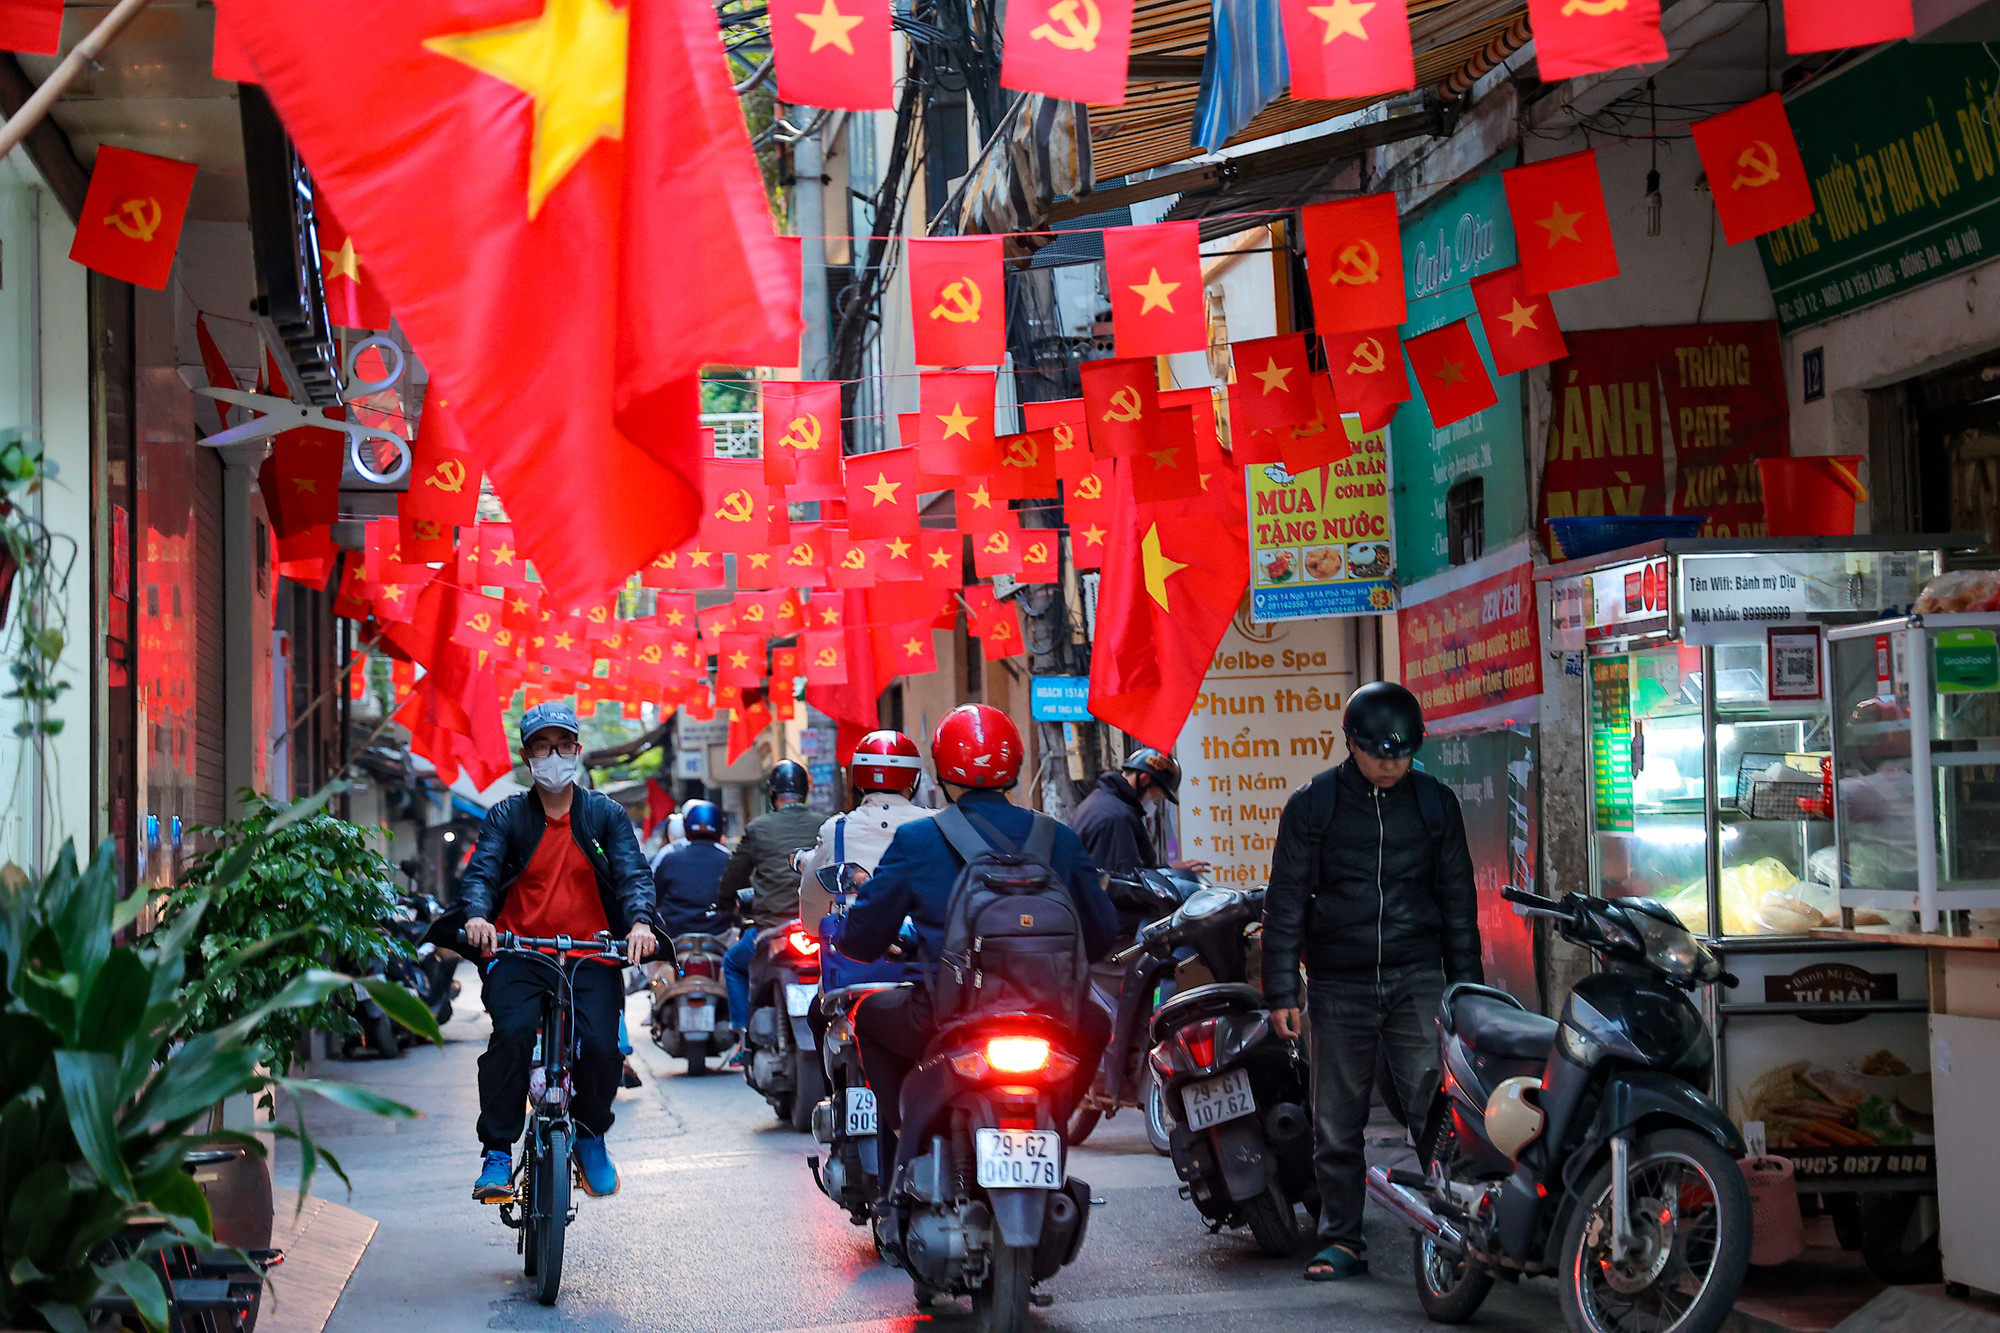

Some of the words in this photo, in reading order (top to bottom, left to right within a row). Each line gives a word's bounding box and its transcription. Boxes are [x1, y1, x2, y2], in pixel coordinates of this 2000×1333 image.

[1815, 153, 1868, 243] NƯỚC
[1854, 142, 1886, 226] ÉP
[1879, 138, 1925, 216] HOA
[1912, 96, 1960, 209] QUẢ
[1806, 291, 1819, 312] 12
[1841, 277, 1853, 301] 18
[1853, 267, 1871, 295] YÊN
[1946, 231, 1963, 260] HÀ
[1961, 225, 1983, 257] NỘI
[1675, 337, 1750, 389] TRỨNG
[1806, 356, 1821, 395] 12
[1680, 405, 1732, 448] PATE
[1365, 435, 1384, 453] GÀ
[1334, 457, 1354, 478] GÀ
[1356, 455, 1386, 478] RÁN
[1256, 488, 1316, 516] MUA
[1335, 483, 1364, 500] CƠM
[1367, 481, 1386, 498] BÒ
[1257, 518, 1317, 547] TẶNG
[1322, 510, 1385, 540] NƯỚC
[1690, 577, 1708, 592] Tên
[1710, 576, 1733, 591] Wifi:
[1735, 575, 1760, 590] Bánh
[1780, 574, 1796, 593] Dịu
[1483, 595, 1502, 624] ZEN
[1502, 584, 1520, 617] ZEN
[1691, 608, 1710, 625] Mật
[1713, 604, 1740, 622] khẩu:
[1742, 606, 1791, 621] 99999999
[1208, 650, 1275, 670] Welbe
[1282, 649, 1327, 671] Spa
[1192, 692, 1265, 716] Phun
[1275, 686, 1341, 712] thêu
[1202, 727, 1279, 759] thẩm
[1291, 731, 1335, 760] mỹ
[1208, 775, 1231, 795] Trị
[1238, 772, 1287, 790] Nám
[1210, 806, 1233, 826] Trị
[1240, 804, 1283, 826] Mụn
[1211, 836, 1234, 856] Trị
[1213, 863, 1257, 886] Triệt
[1191, 1074, 1242, 1101] 29-G1
[856, 1092, 873, 1110] 29
[1194, 1094, 1249, 1125] 107.62
[850, 1113, 878, 1130] 909
[991, 1135, 1047, 1160] 29-G2
[984, 1159, 1055, 1186] 000.78
[1843, 1156, 1879, 1174] 087
[1887, 1155, 1927, 1173] 444
